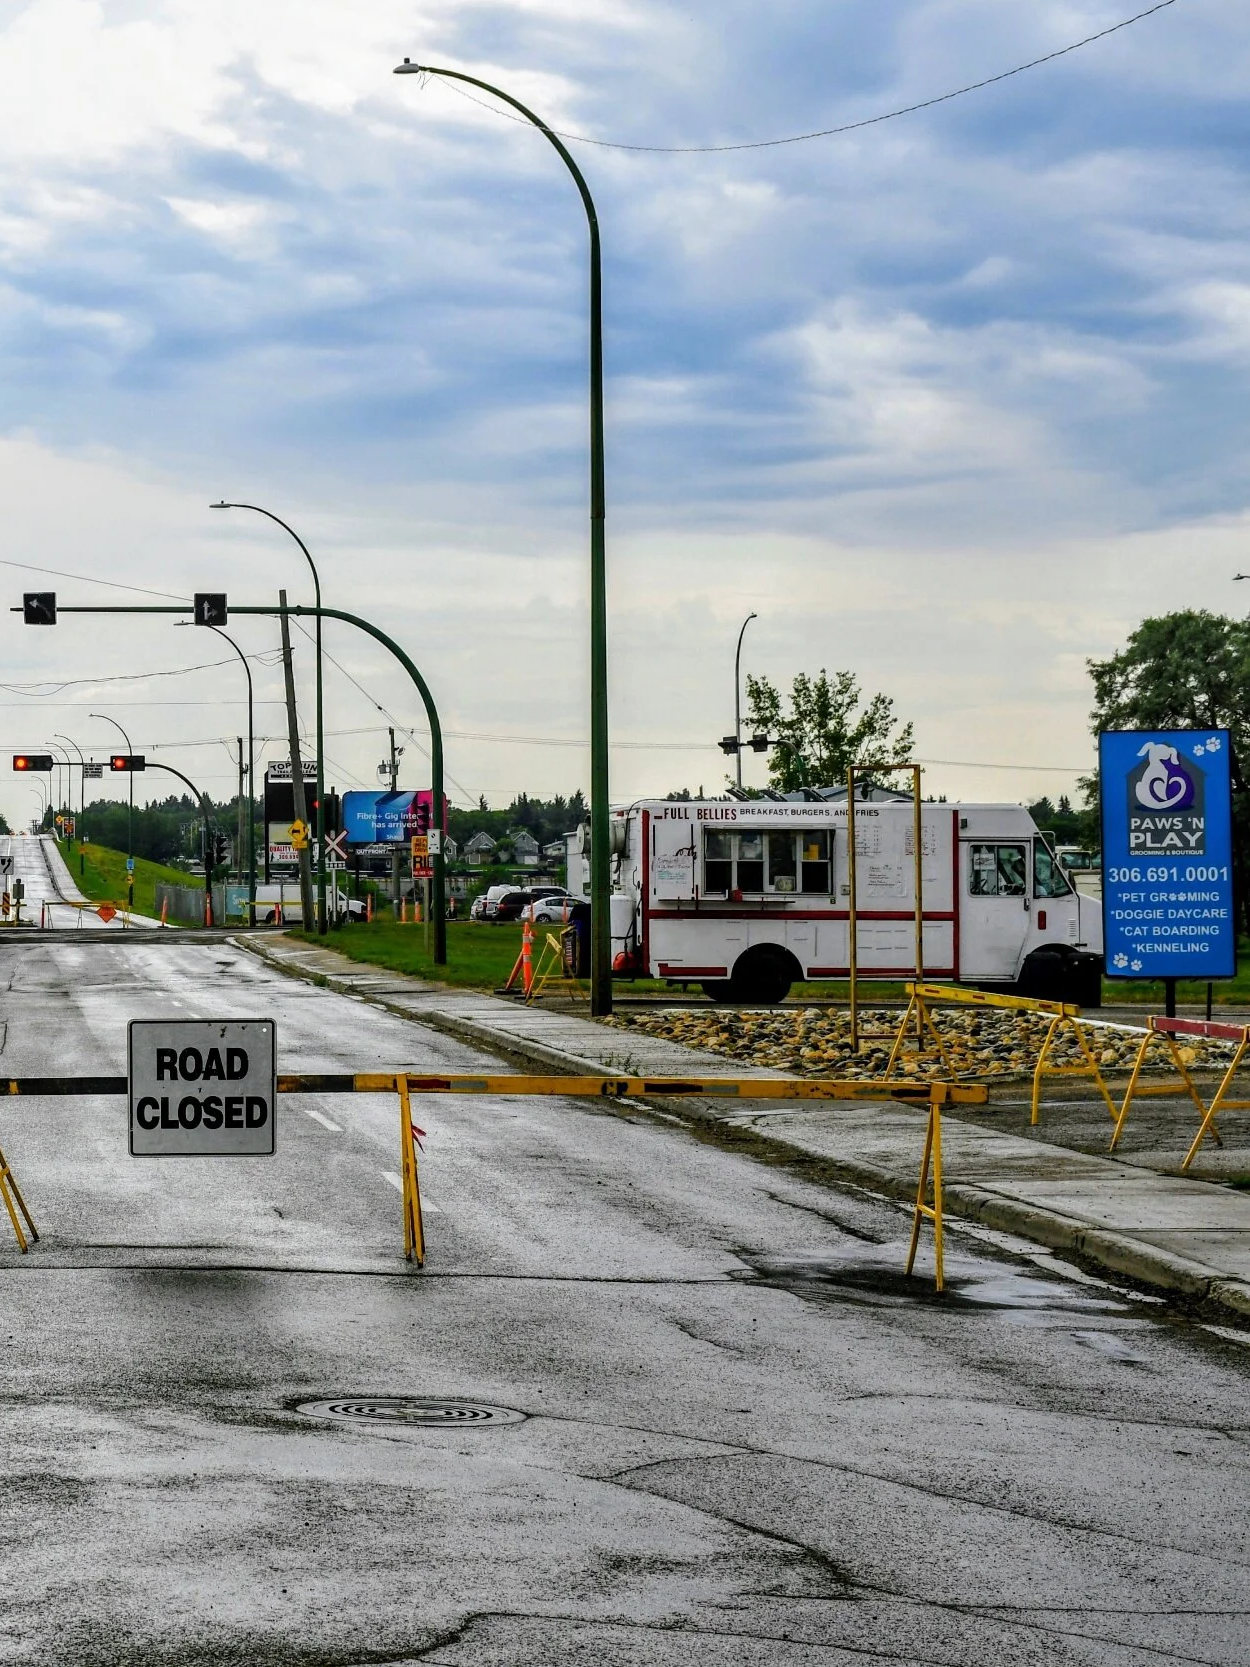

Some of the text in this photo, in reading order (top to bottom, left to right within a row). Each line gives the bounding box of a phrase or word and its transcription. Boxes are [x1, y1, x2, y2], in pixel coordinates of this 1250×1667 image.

[270, 763, 318, 771] TOP UN
[385, 813, 398, 821] Gig
[663, 808, 689, 820] FULL
[697, 808, 737, 820] BELLIES
[740, 808, 789, 816] BREAKFAST,
[1131, 817, 1182, 829] PAWS
[1130, 832, 1203, 848] PLAY
[1109, 866, 1228, 882] 306.691.0001
[1168, 909, 1228, 919] DAYCARE
[1152, 926, 1220, 936] BOARDING
[156, 1047, 249, 1081] ROAD
[137, 1096, 268, 1130] CLOSED
